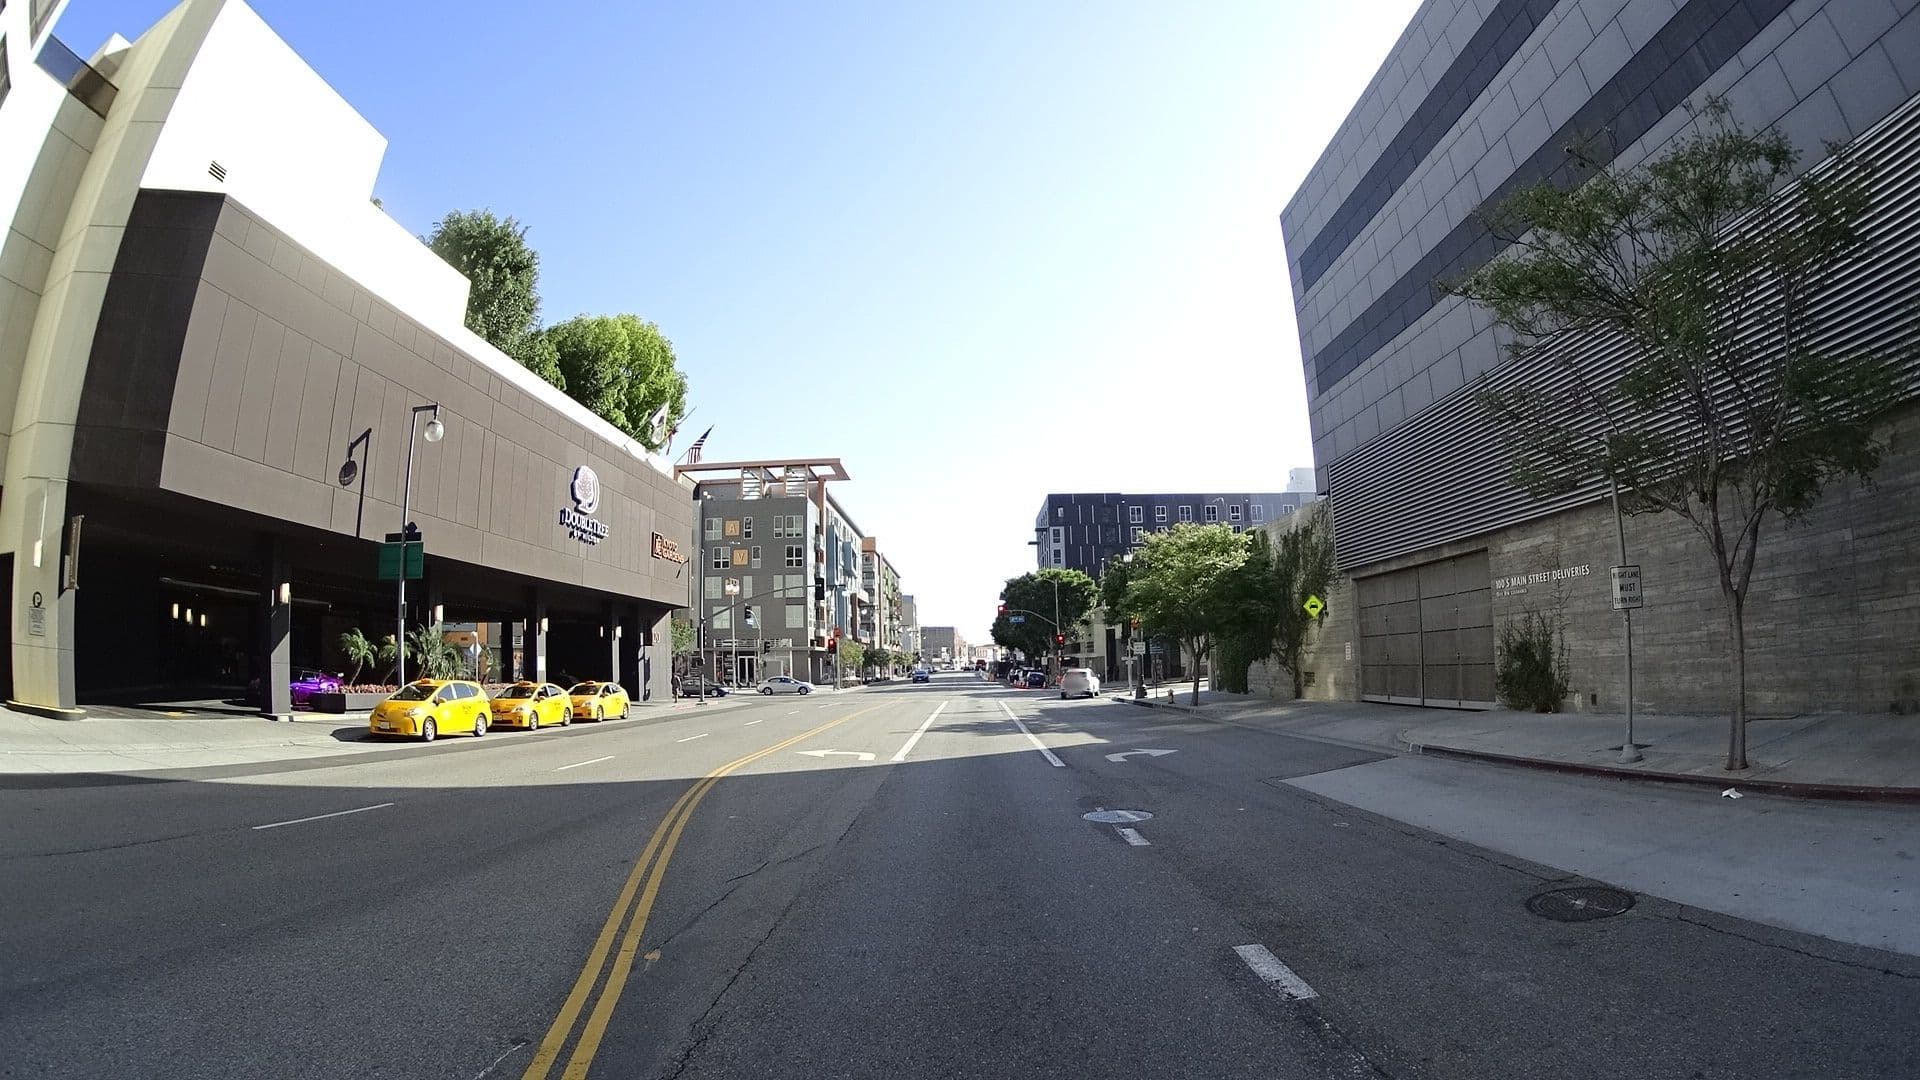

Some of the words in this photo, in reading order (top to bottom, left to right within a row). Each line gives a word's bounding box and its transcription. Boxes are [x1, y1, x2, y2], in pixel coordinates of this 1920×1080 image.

[1511, 575, 1527, 587] MAIN
[1528, 571, 1550, 585] STREET
[1552, 564, 1590, 581] DELIVERIES
[1620, 583, 1635, 592] MUST
